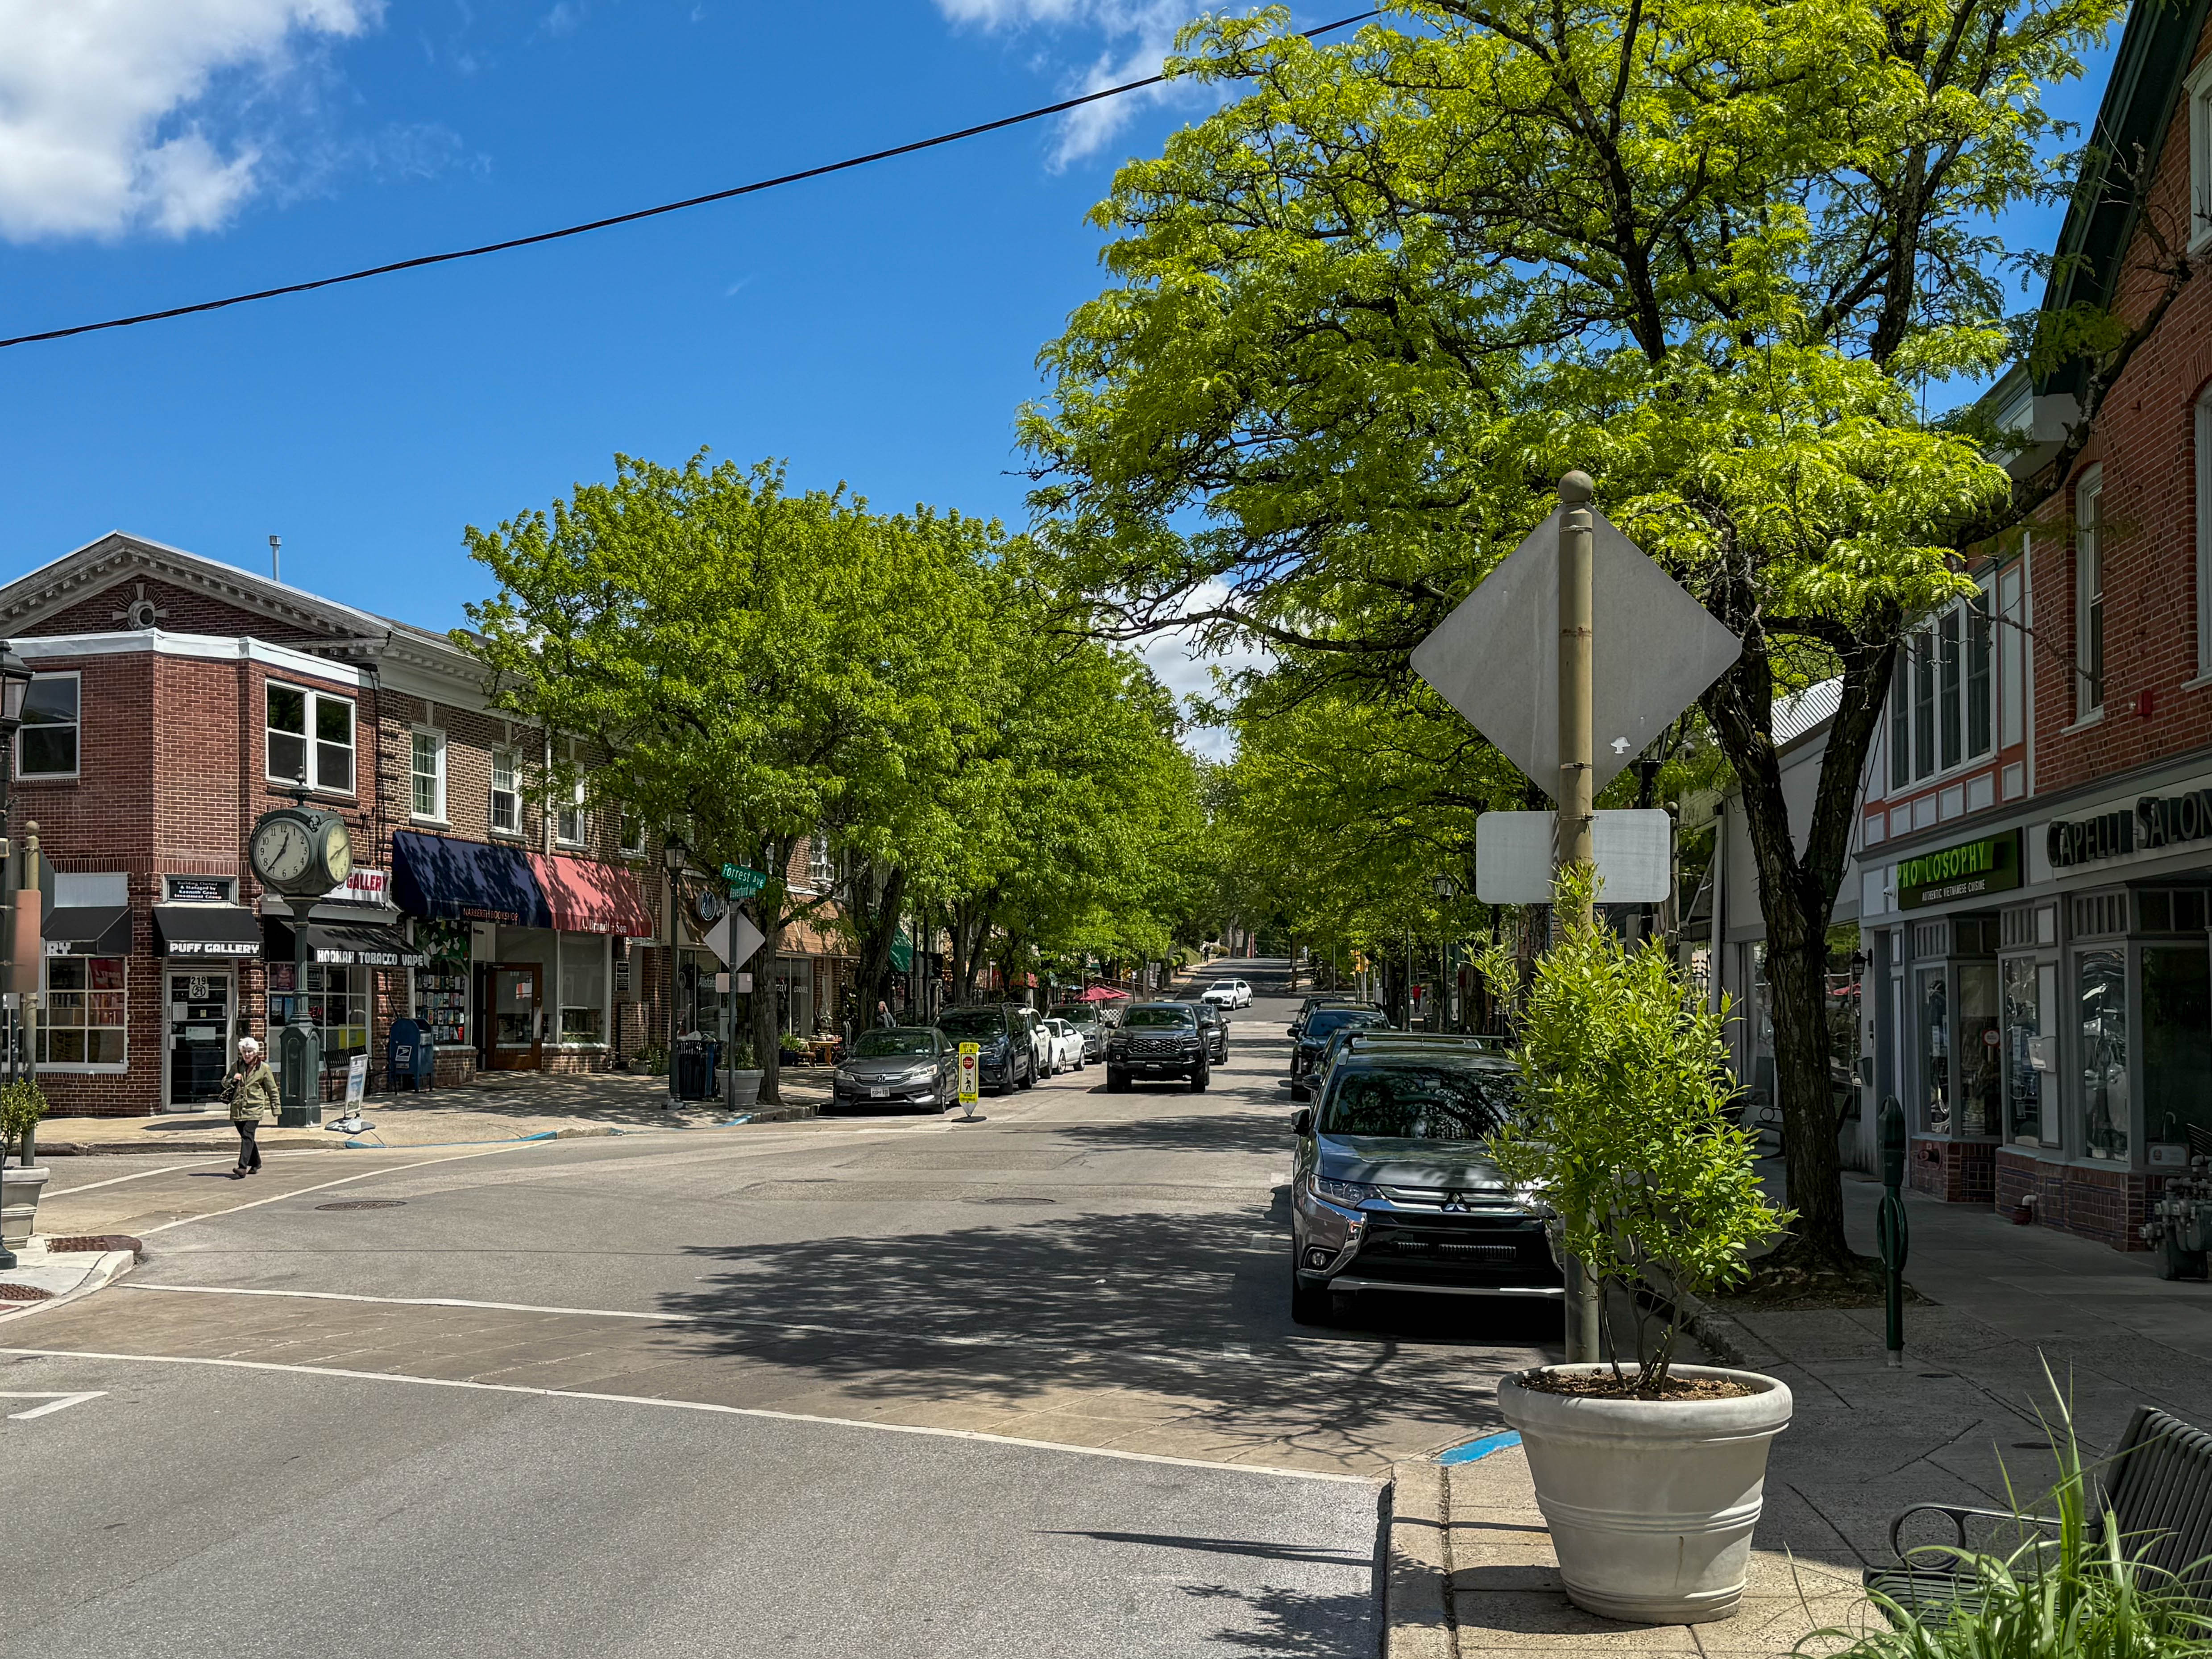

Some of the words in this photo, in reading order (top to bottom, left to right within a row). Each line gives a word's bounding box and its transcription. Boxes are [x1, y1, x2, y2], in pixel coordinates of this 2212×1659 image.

[271, 828, 276, 836] 11
[262, 837, 269, 845] 10
[300, 836, 304, 844] 2
[2047, 809, 2133, 867] CAPELLI
[263, 858, 268, 866] 8
[300, 857, 304, 865] 4
[282, 869, 286, 877] 6
[293, 866, 298, 874] 5
[723, 864, 750, 883] Forrest
[347, 873, 389, 892] GALLERY
[1943, 883, 1967, 897] VIETNAMESE
[1968, 879, 1985, 892] CUISINE
[170, 943, 202, 953] PUFF
[204, 943, 260, 954] GALLERY
[359, 951, 398, 965] TOBACCO
[401, 953, 423, 967] VAPE
[191, 977, 206, 985] 219
